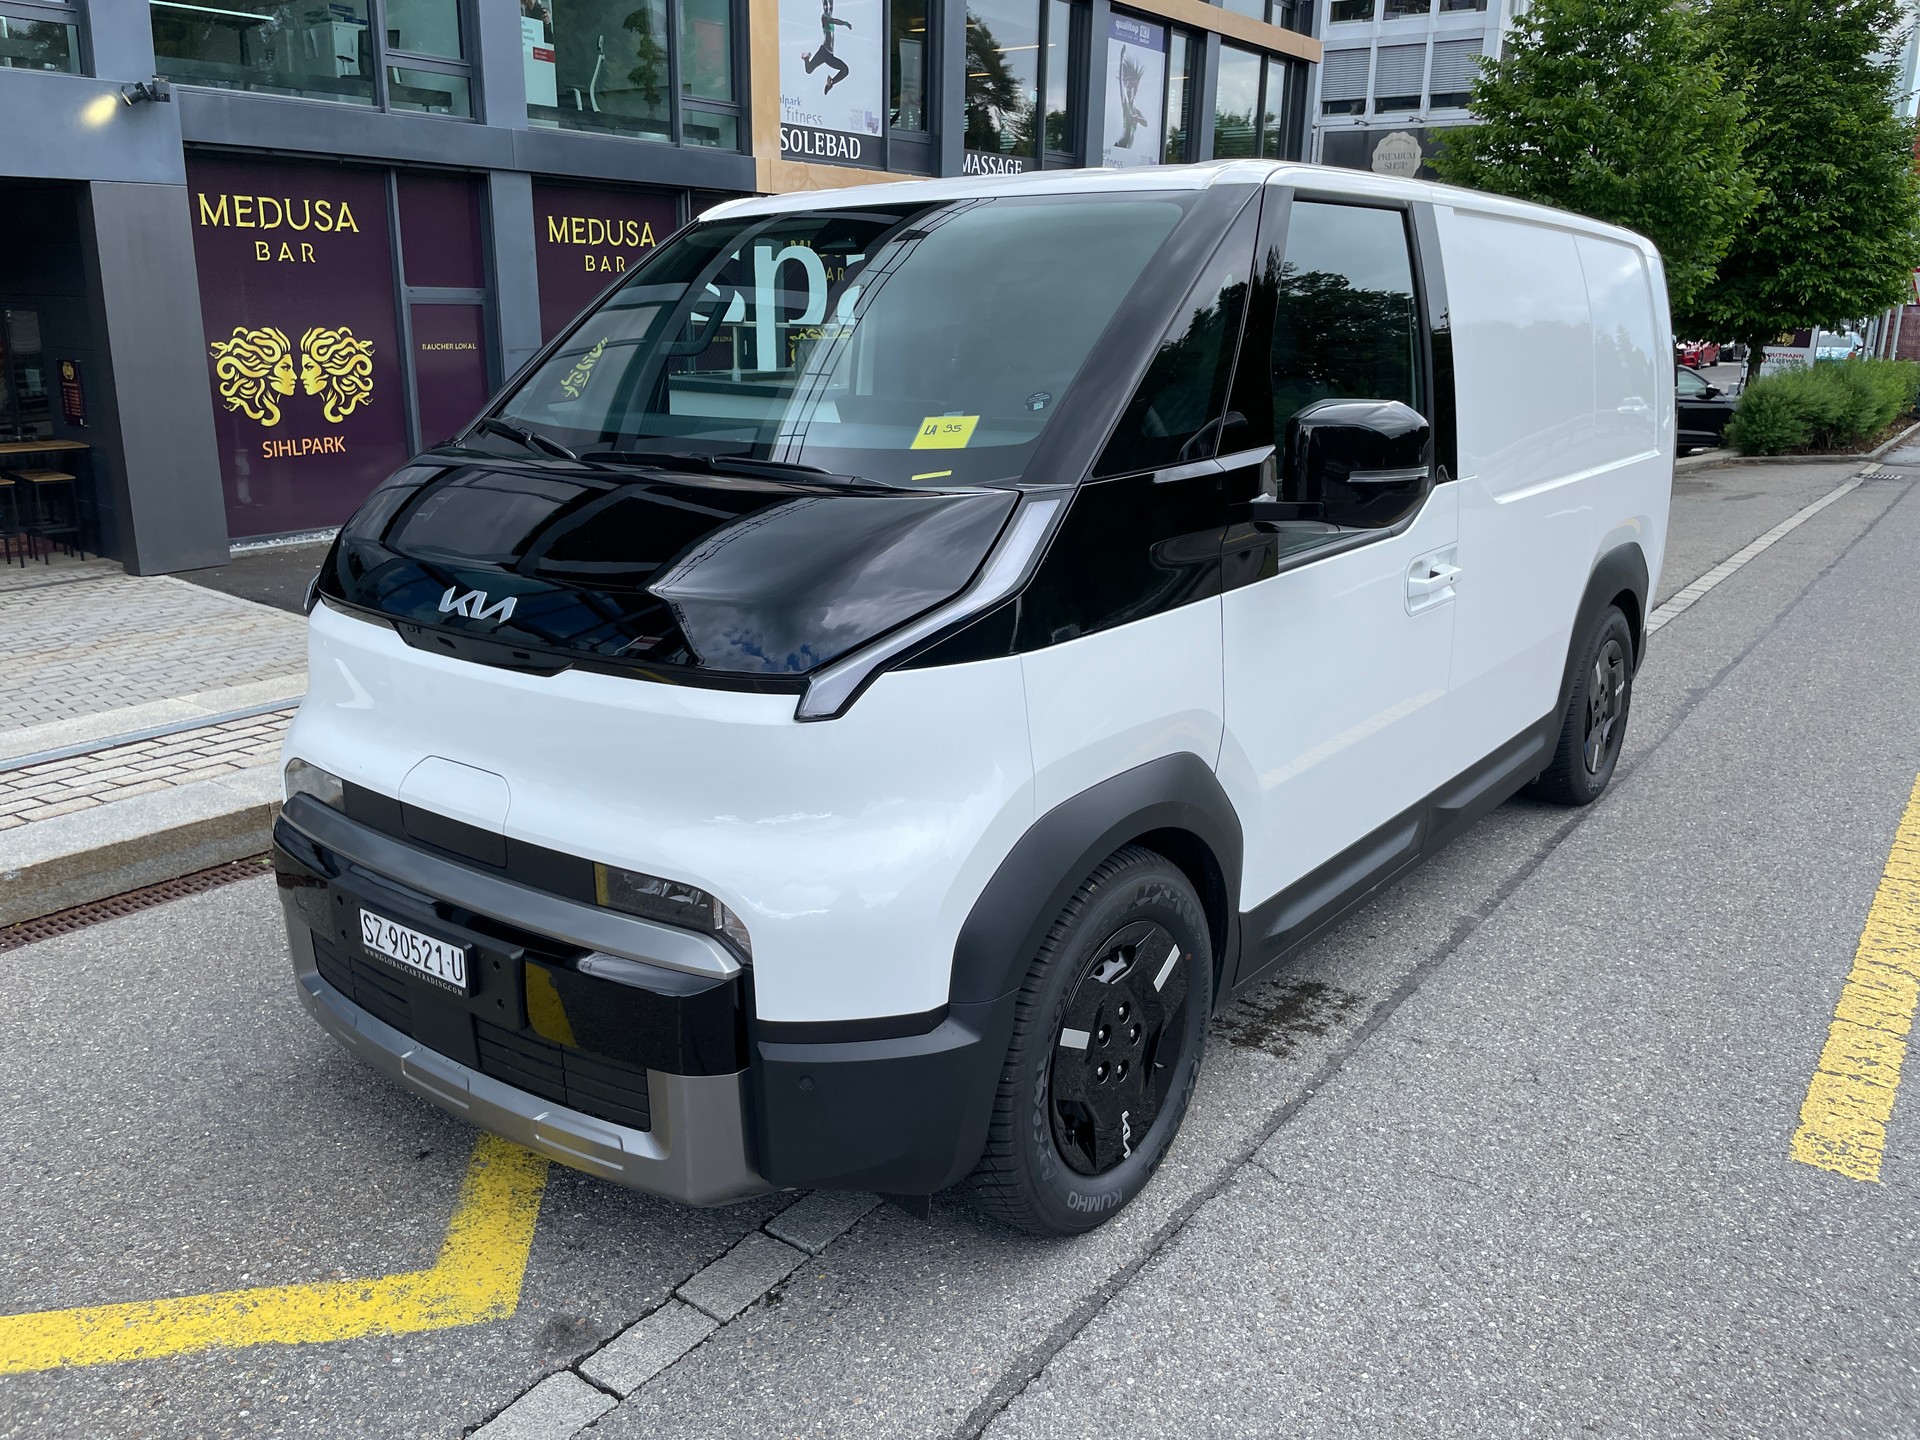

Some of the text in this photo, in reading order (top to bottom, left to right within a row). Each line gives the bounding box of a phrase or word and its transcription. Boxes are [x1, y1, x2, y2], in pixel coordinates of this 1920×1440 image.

[786, 106, 823, 126] fitness
[780, 127, 861, 160] SOLEBAD
[1377, 152, 1416, 161] PREMIUM
[197, 192, 360, 233] MEDUSA
[547, 215, 656, 248] MEDUSA
[255, 241, 316, 263] BAR
[584, 254, 626, 272] BAR
[421, 342, 477, 351] RAUCHER LOKAL
[923, 424, 938, 436] LA
[262, 436, 346, 459] SIHLPARK
[438, 585, 517, 624] KIA
[1066, 1188, 1123, 1213] KUMHO
